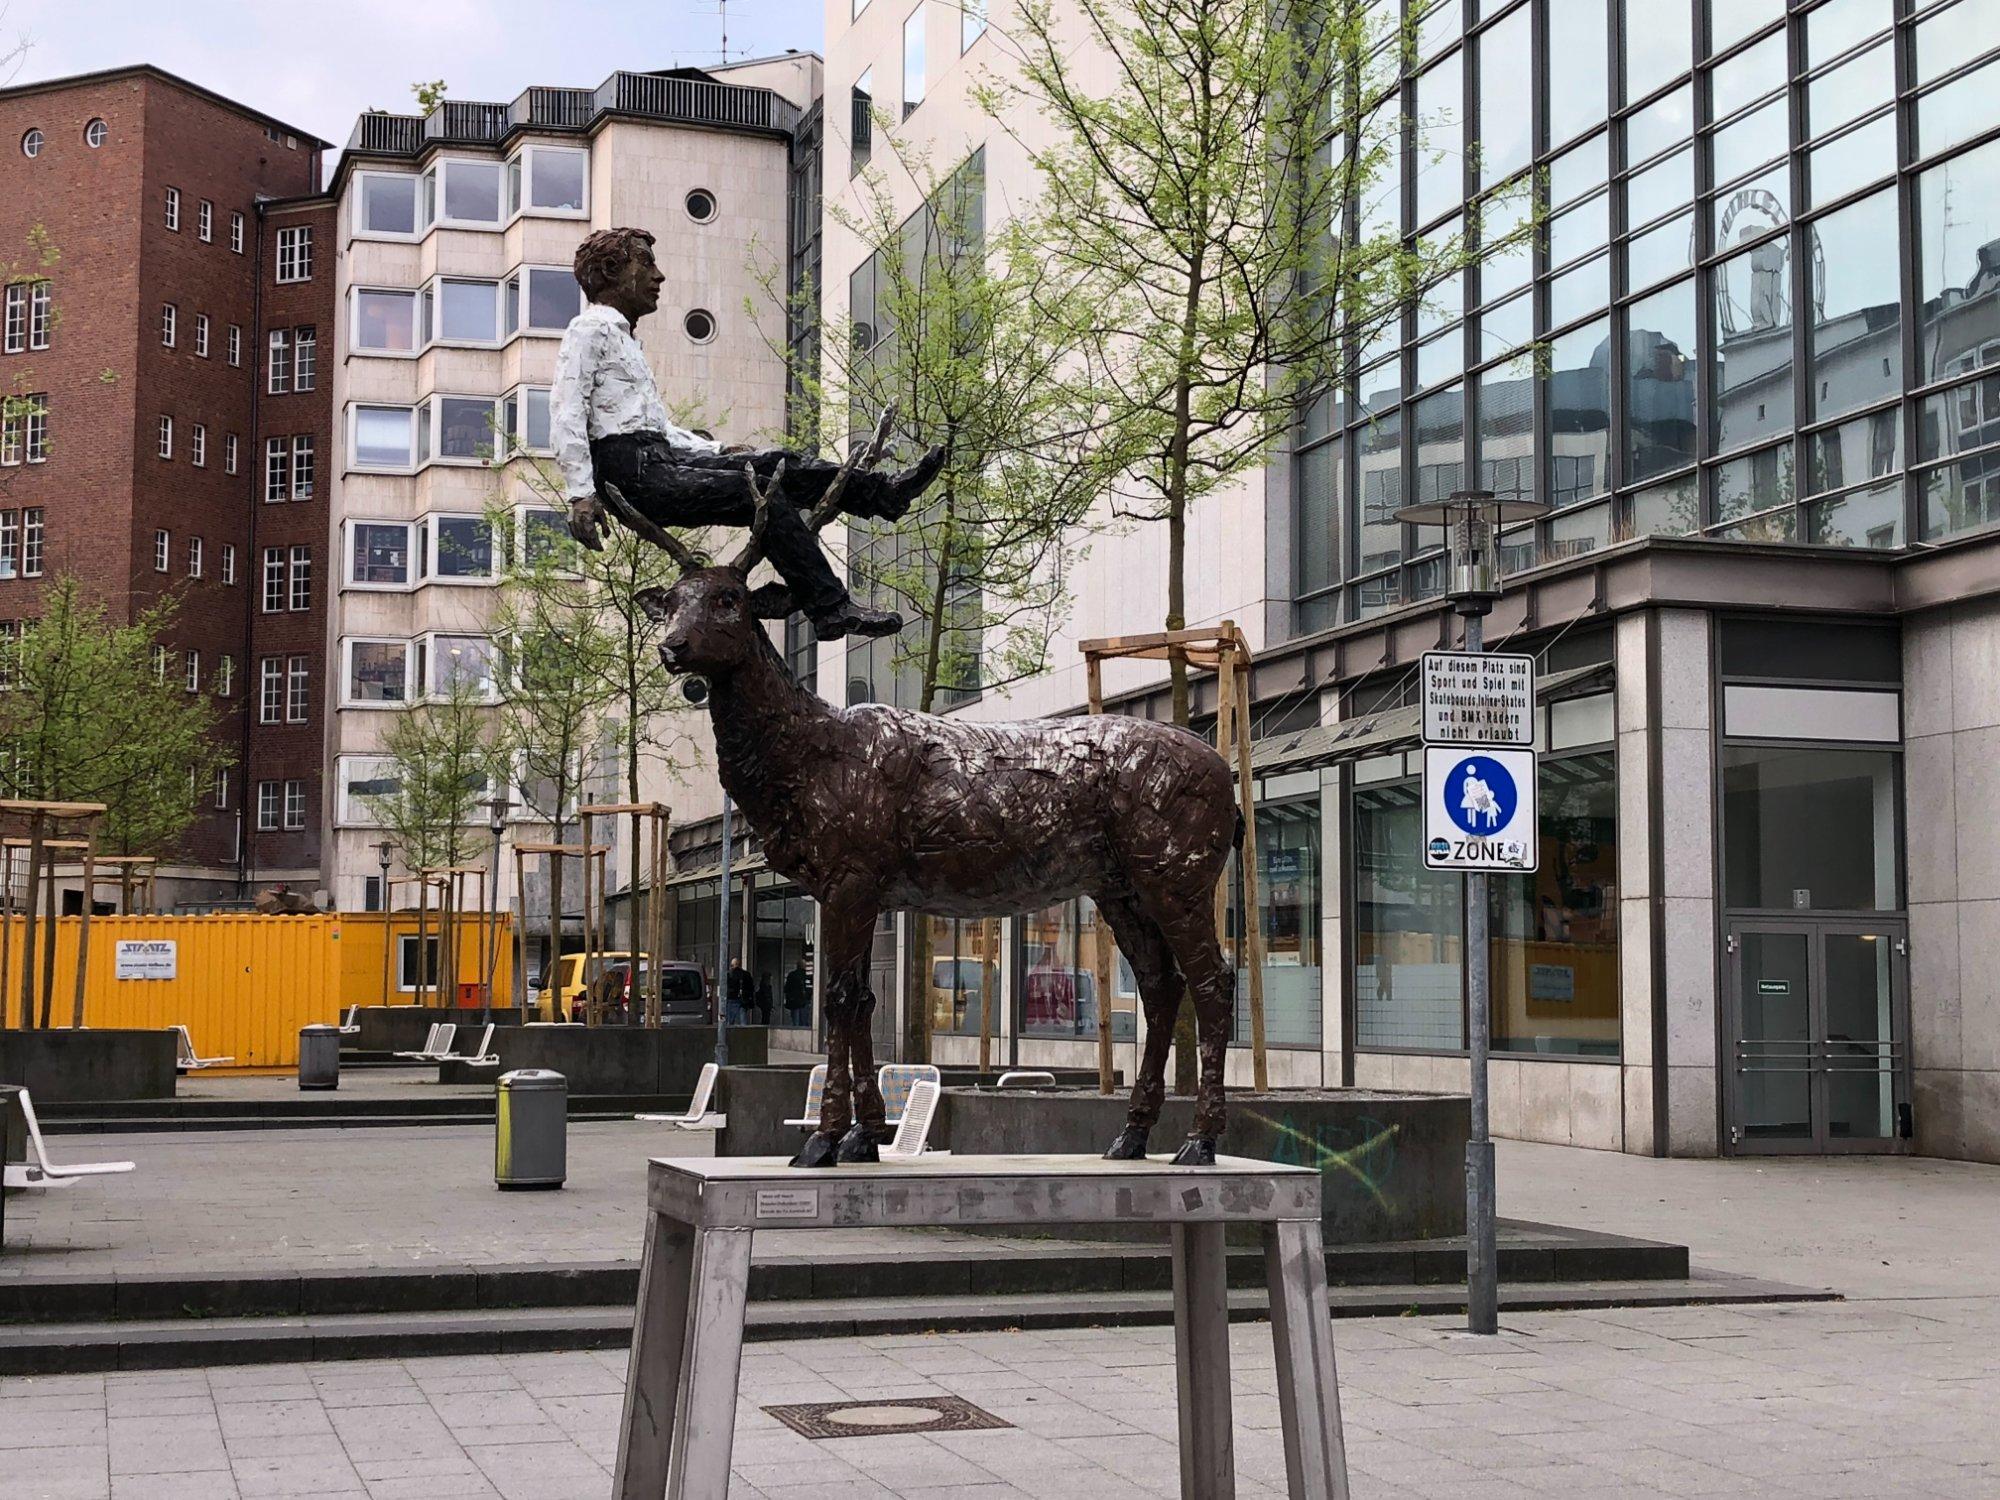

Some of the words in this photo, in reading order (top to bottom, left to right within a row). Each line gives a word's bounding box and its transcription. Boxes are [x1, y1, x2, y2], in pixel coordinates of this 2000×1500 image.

[1428, 659, 1443, 672] Auf
[1448, 659, 1477, 673] diesem
[1482, 660, 1504, 673] Platz
[1509, 662, 1526, 674] sind
[1431, 675, 1456, 690] Sport
[1462, 676, 1477, 689] und
[1483, 676, 1505, 692] Spiel
[1511, 678, 1525, 691] mit
[1438, 710, 1455, 722] und
[1440, 725, 1469, 739] nicht
[1477, 727, 1519, 741] erlaubt
[1453, 841, 1505, 861] ZONE
